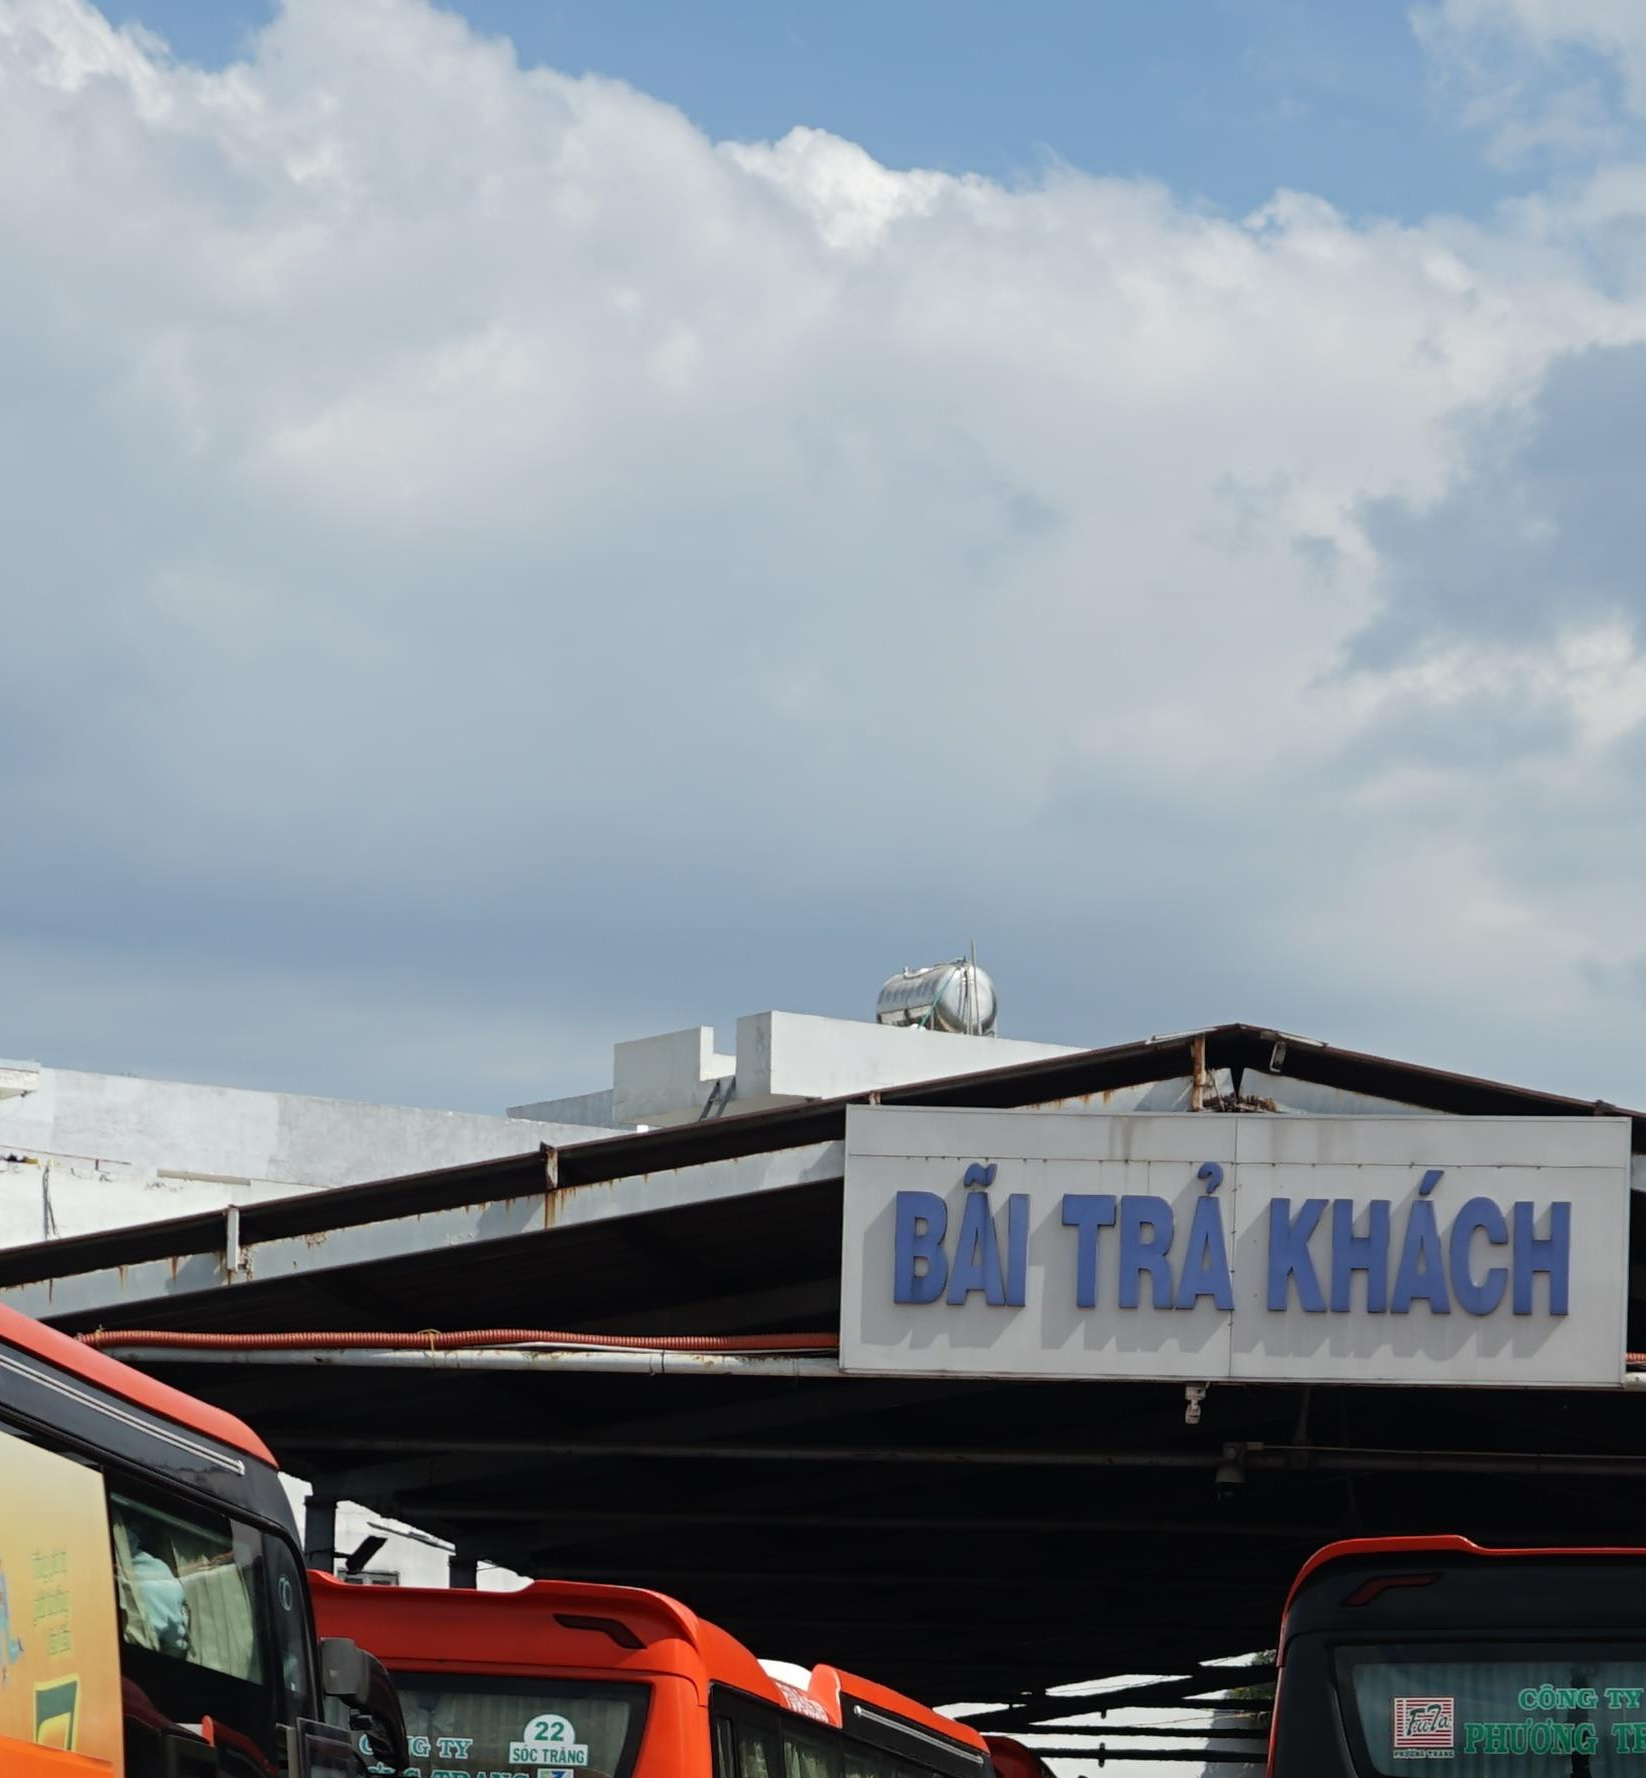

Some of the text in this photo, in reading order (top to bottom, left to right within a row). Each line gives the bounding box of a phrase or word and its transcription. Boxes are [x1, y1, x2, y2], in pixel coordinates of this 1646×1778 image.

[892, 1160, 1572, 1317] BÃI TRẢ KHÁCH
[1518, 1684, 1644, 1711] CÔNG TY
[533, 1721, 565, 1742] 22
[1463, 1718, 1599, 1755] PHƯƠNG
[436, 1736, 474, 1759] TY
[512, 1744, 585, 1765] SÓC TRĂNG
